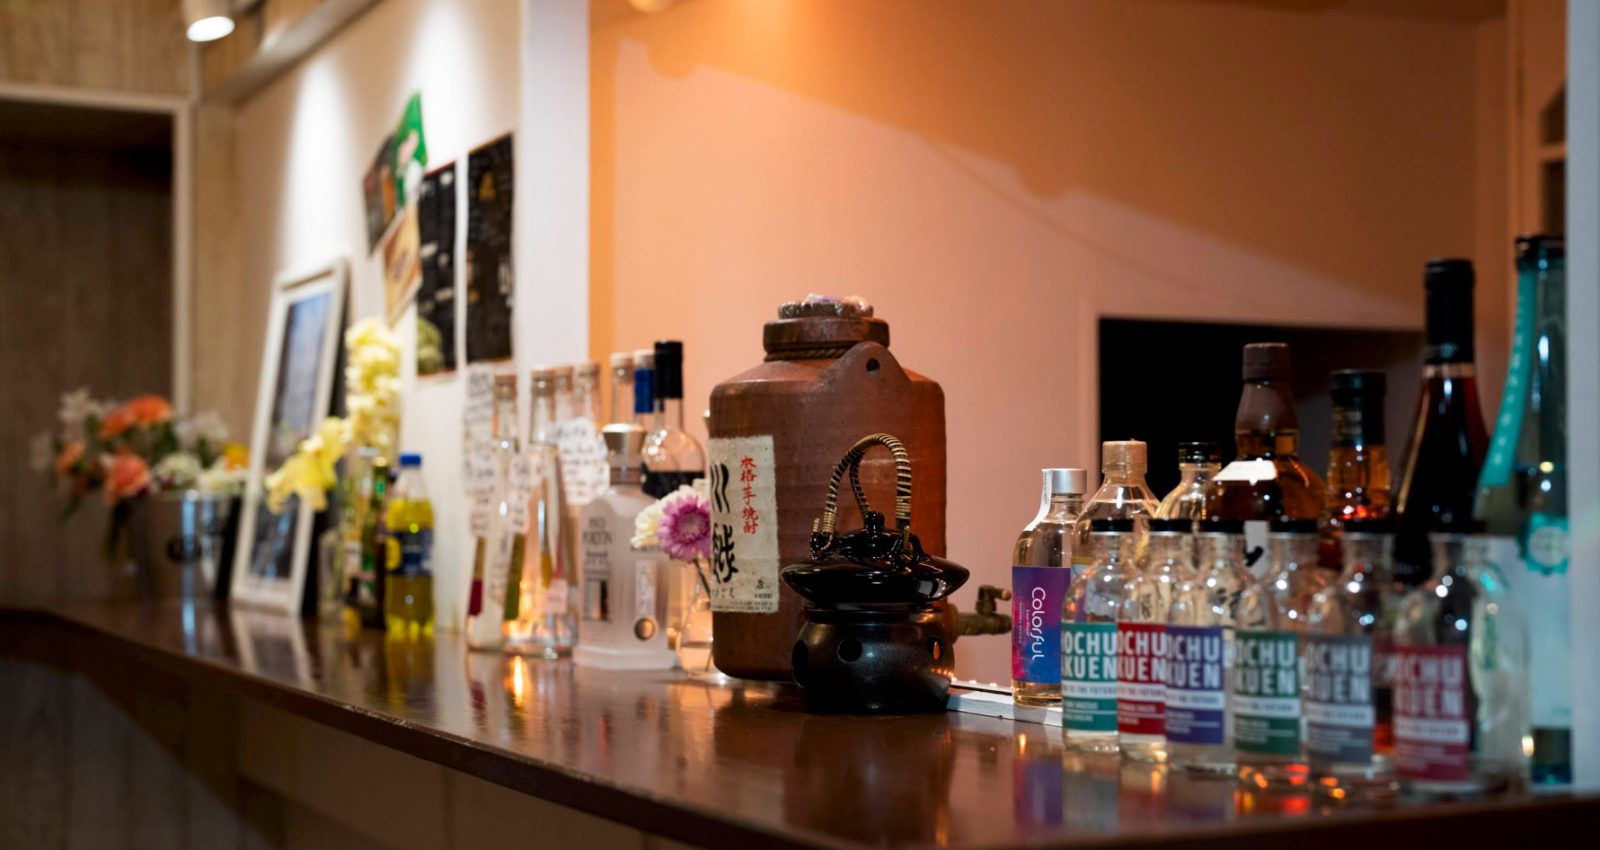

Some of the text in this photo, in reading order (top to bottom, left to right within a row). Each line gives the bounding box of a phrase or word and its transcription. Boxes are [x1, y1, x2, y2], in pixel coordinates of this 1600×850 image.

[740, 456, 759, 535] 本格芋焼酎
[1031, 587, 1046, 660] Colorful
[1062, 631, 1117, 655] OCHU
[1062, 656, 1117, 679] KUEN
